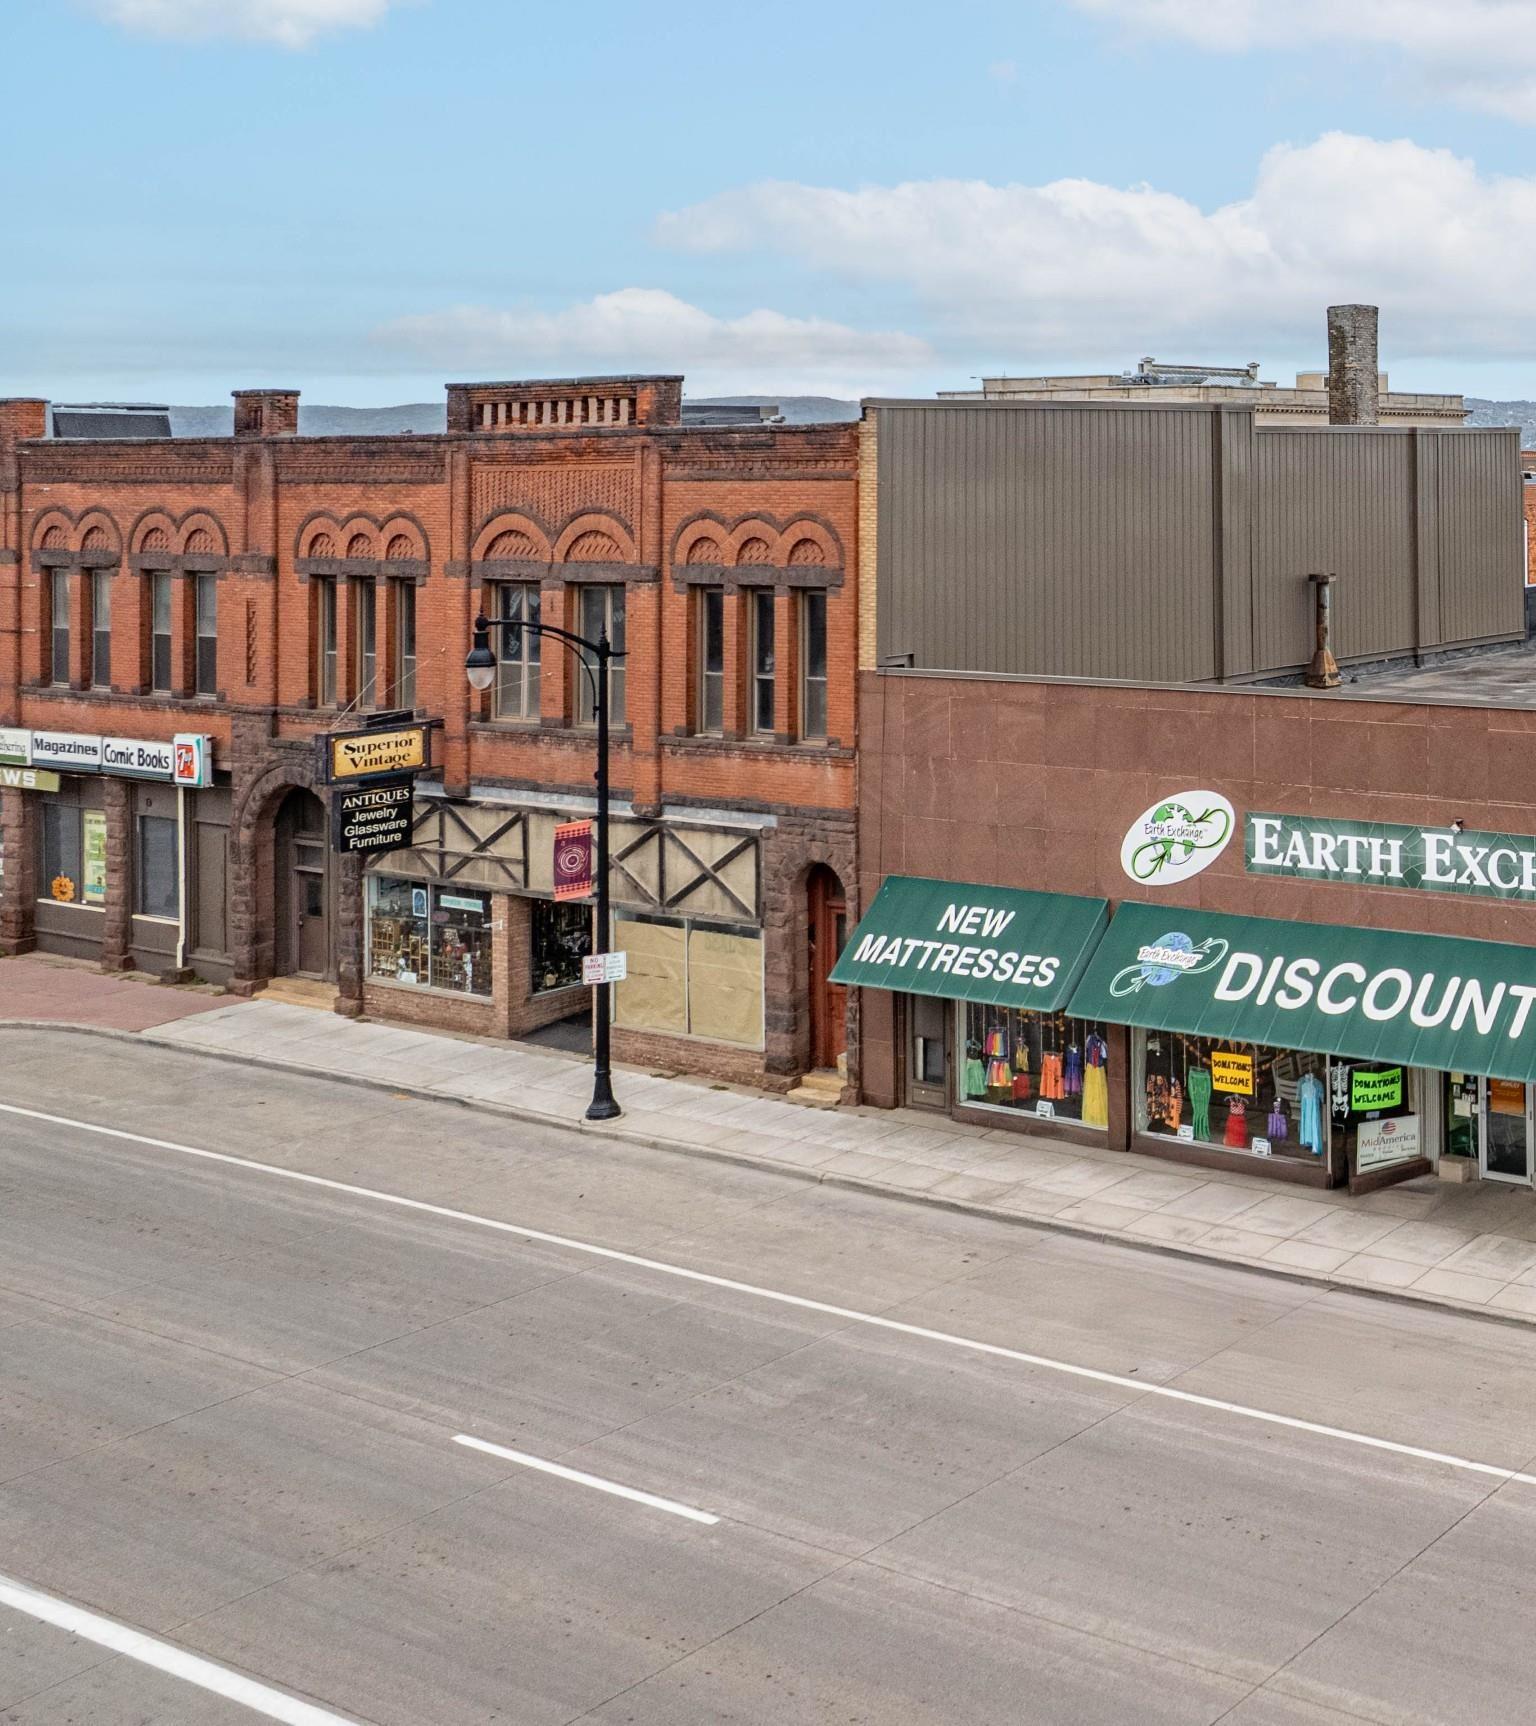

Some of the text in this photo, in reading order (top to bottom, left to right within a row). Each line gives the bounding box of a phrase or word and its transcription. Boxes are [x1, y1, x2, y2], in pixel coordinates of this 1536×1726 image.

[34, 738, 98, 756] Magazines
[343, 735, 417, 756] Superior
[104, 743, 170, 770] Comic Books
[349, 751, 411, 771] Vintage
[0, 768, 36, 787] WS
[342, 788, 410, 809] ANTIQUES
[351, 807, 398, 823] Jewelry
[344, 819, 408, 837] Glassware
[1144, 823, 1204, 842] Earth Exchange
[349, 832, 402, 849] Furniture
[1250, 817, 1404, 878] EARTH
[936, 903, 1016, 939] NEW
[851, 933, 1061, 988] MATTRESSES
[1140, 948, 1197, 968] Earth Exchange
[1212, 1059, 1253, 1073] DONATIONS
[1213, 1074, 1250, 1088] WELCOME
[1354, 1074, 1400, 1089] DONATIONS
[1354, 1090, 1396, 1104] WELCOME
